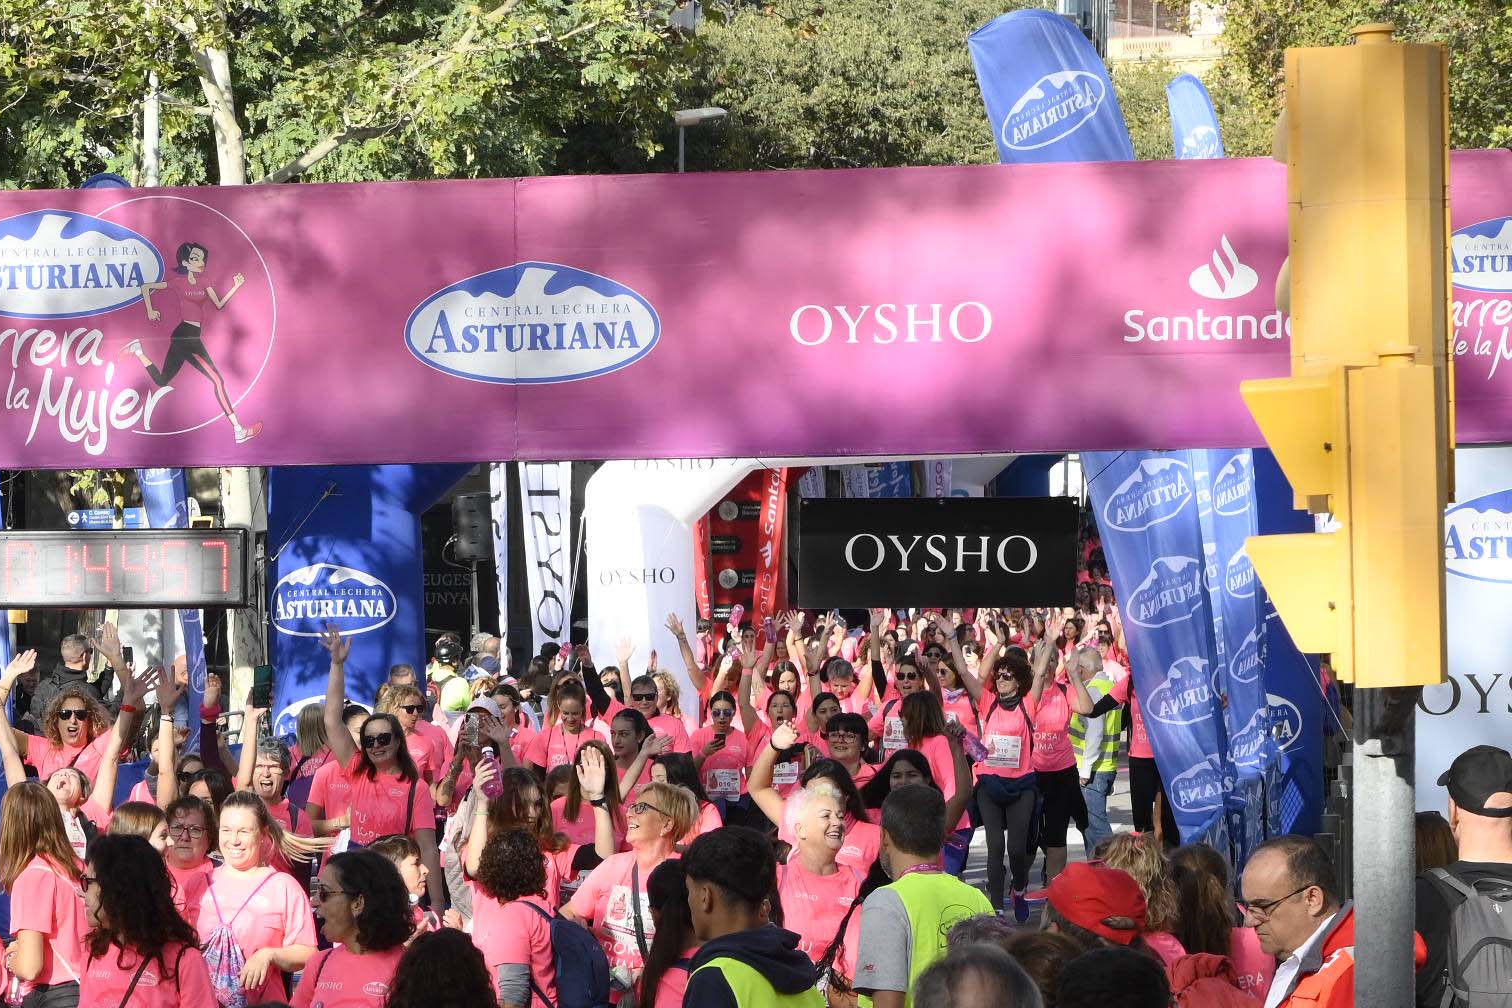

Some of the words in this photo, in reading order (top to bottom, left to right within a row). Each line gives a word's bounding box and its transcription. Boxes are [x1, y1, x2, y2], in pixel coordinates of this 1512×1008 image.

[67, 246, 139, 257] LECHERA
[464, 303, 545, 318] CENTRAL
[551, 301, 632, 316] LECHERA
[790, 301, 993, 345] OYSHO
[425, 310, 640, 354] ASTURIANA
[6, 371, 30, 410] la
[25, 363, 174, 456] Mujer
[844, 533, 1038, 574] OYSHO
[600, 567, 675, 585] OYSHO
[276, 593, 388, 620] ASTURIANA
[288, 589, 329, 598] CENTRAL
[335, 588, 383, 597] LECHERA
